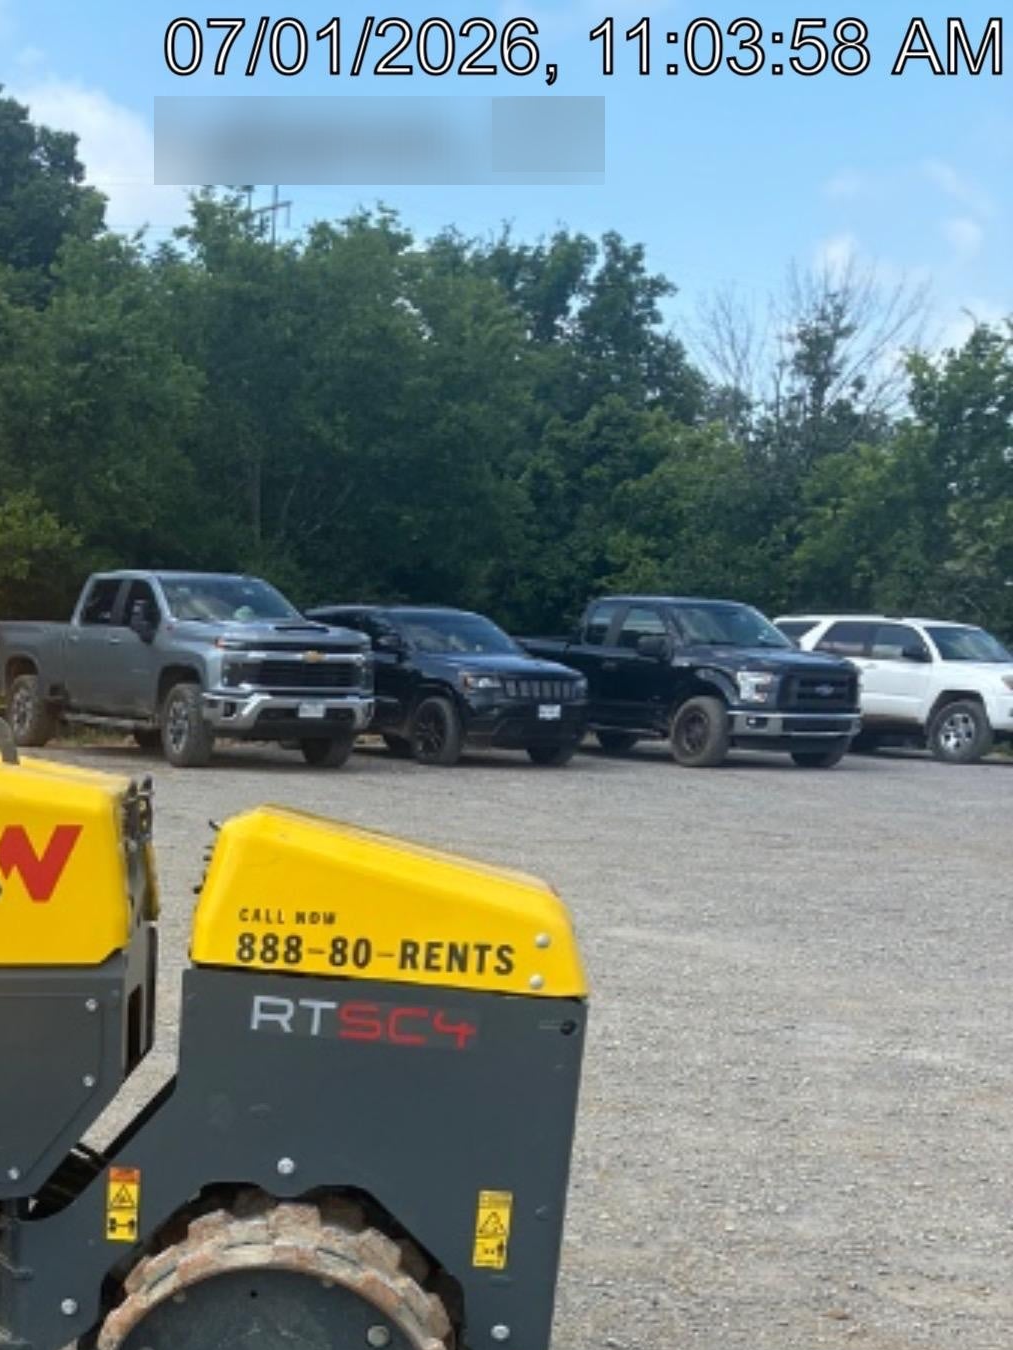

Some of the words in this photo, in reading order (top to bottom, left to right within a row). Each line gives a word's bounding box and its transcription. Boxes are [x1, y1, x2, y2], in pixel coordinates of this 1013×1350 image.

[238, 908, 286, 925] CALL
[294, 911, 337, 925] NOW
[237, 932, 516, 976] 888-80-RENTS
[250, 995, 477, 1049] RTSC4
